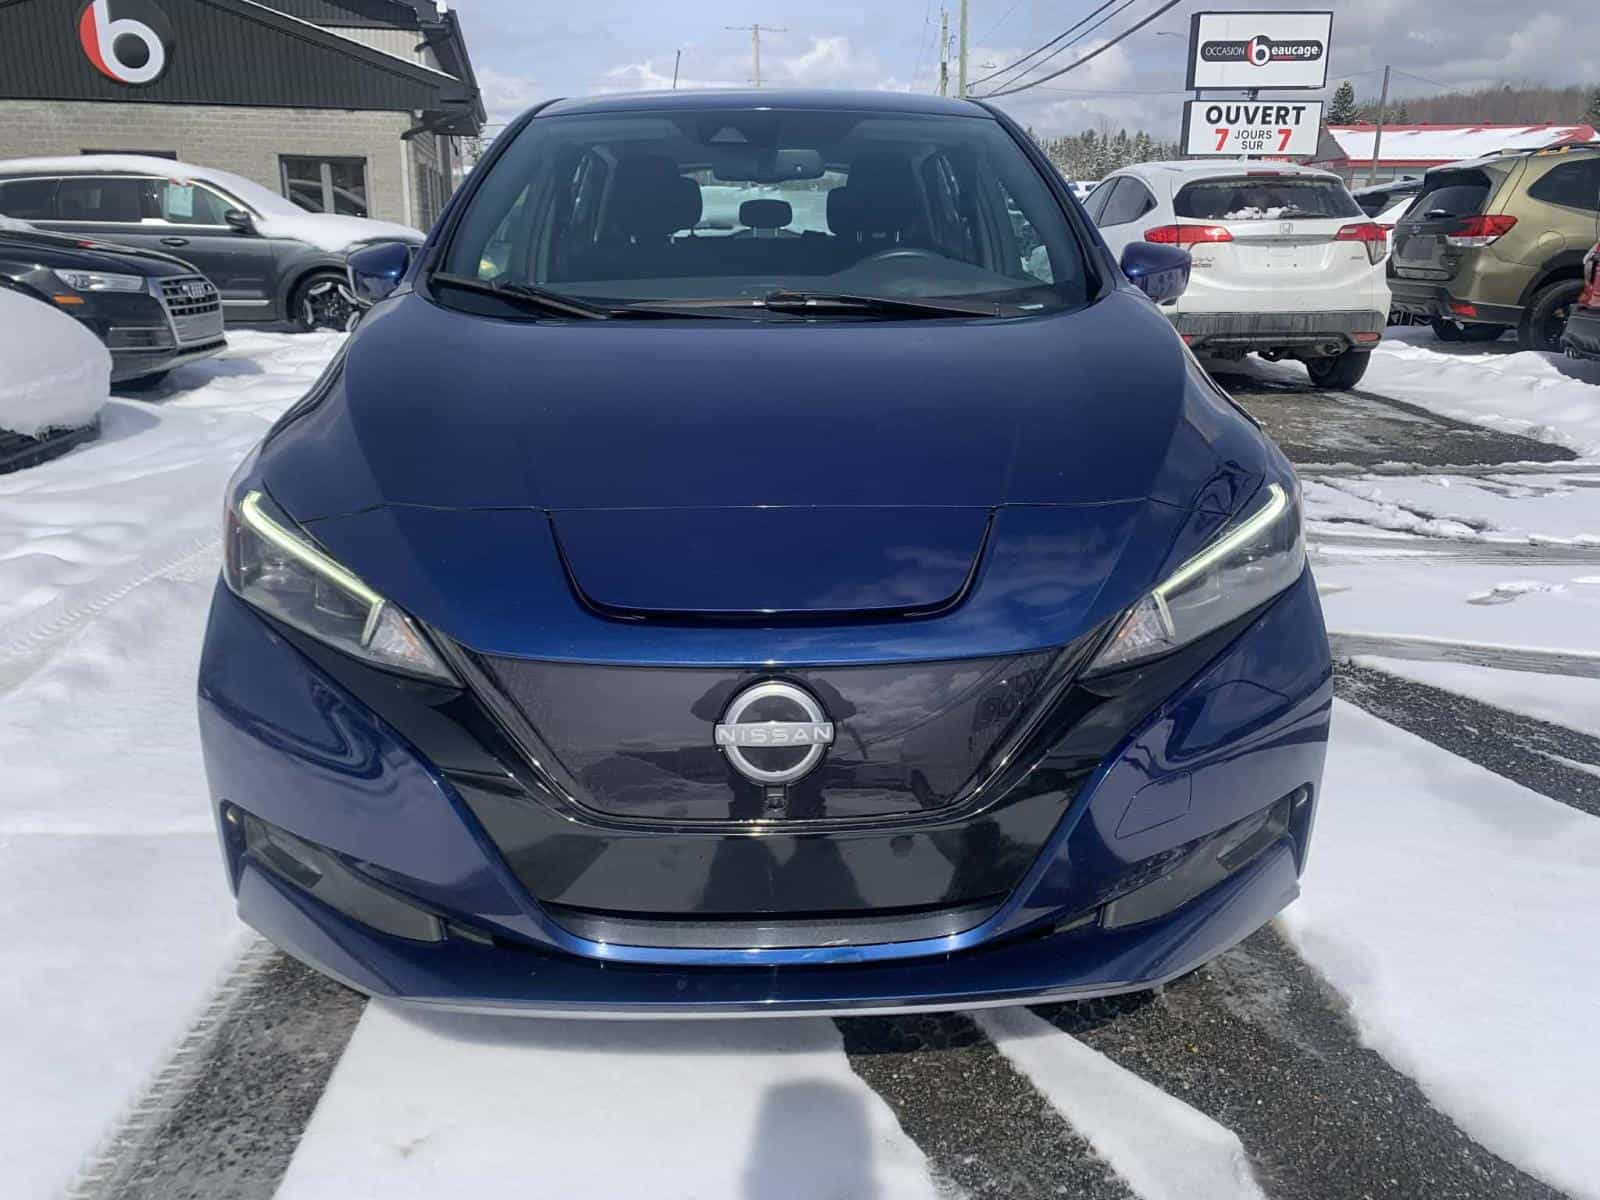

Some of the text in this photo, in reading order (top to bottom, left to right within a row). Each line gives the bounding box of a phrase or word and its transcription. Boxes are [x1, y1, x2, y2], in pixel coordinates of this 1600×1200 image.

[1205, 46, 1245, 56] OCCASION
[1205, 105, 1306, 125] OUVERT
[1215, 128, 1292, 151] 7 JOURS 7
[1241, 141, 1263, 150] SUR
[719, 726, 831, 743] NISSAN
